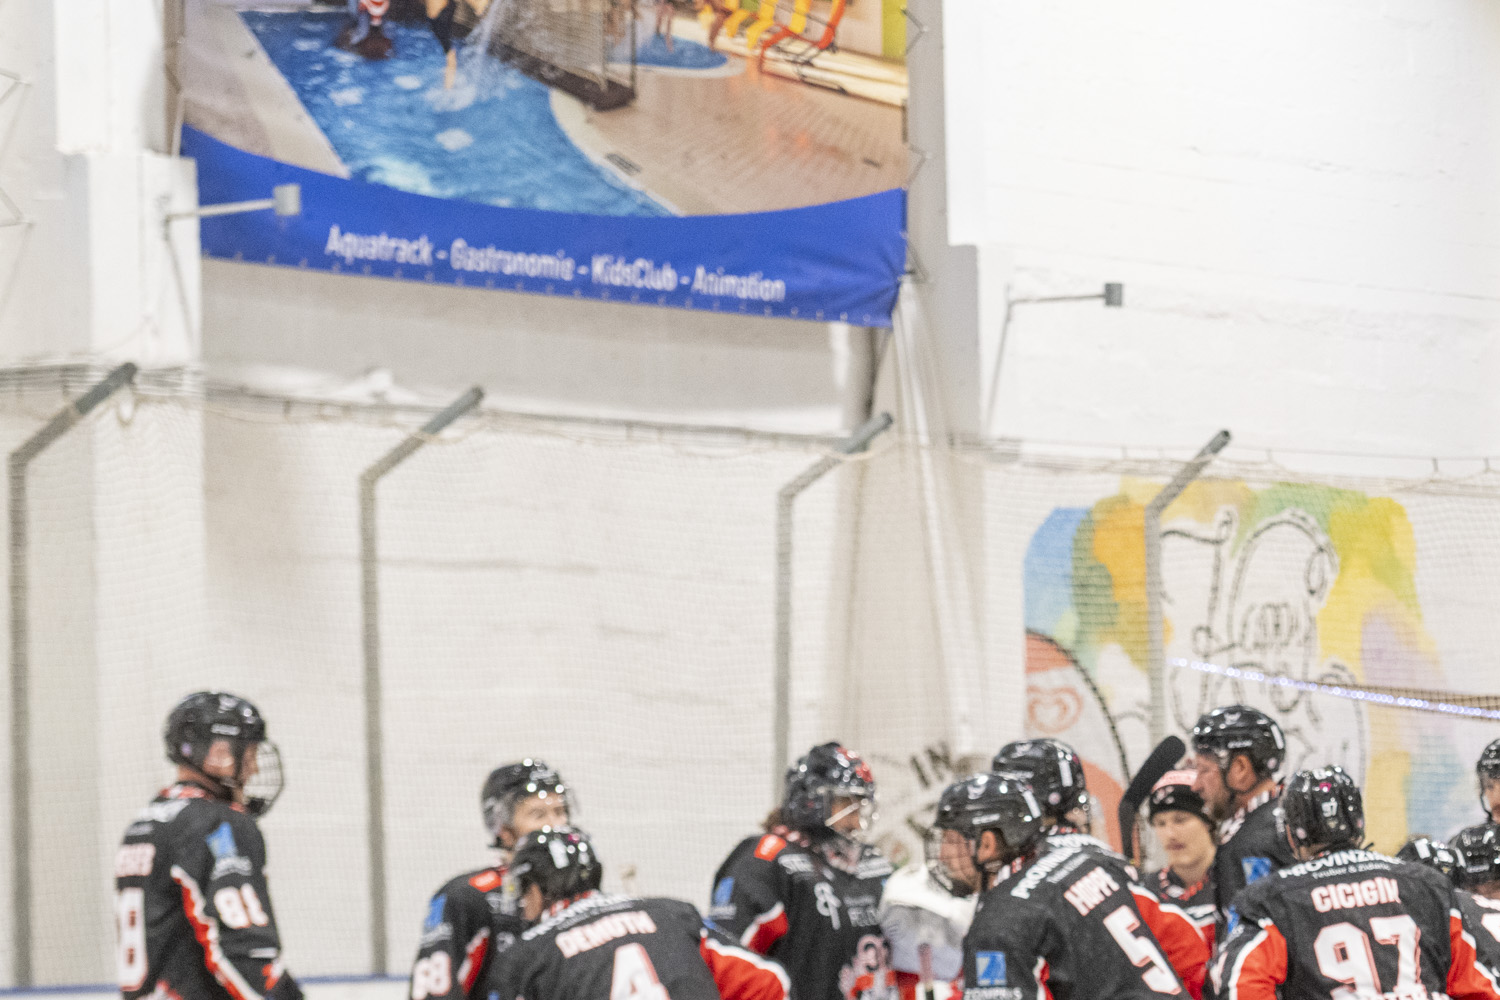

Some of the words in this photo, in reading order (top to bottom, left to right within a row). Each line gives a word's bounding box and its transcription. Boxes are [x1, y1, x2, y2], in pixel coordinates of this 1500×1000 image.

[325, 225, 434, 266] Aquatrack
[449, 238, 576, 281] Gastronomie
[591, 254, 678, 292] KidsClub
[691, 264, 786, 303] Animation
[1322, 801, 1338, 818] 97
[1102, 904, 1182, 996] 5
